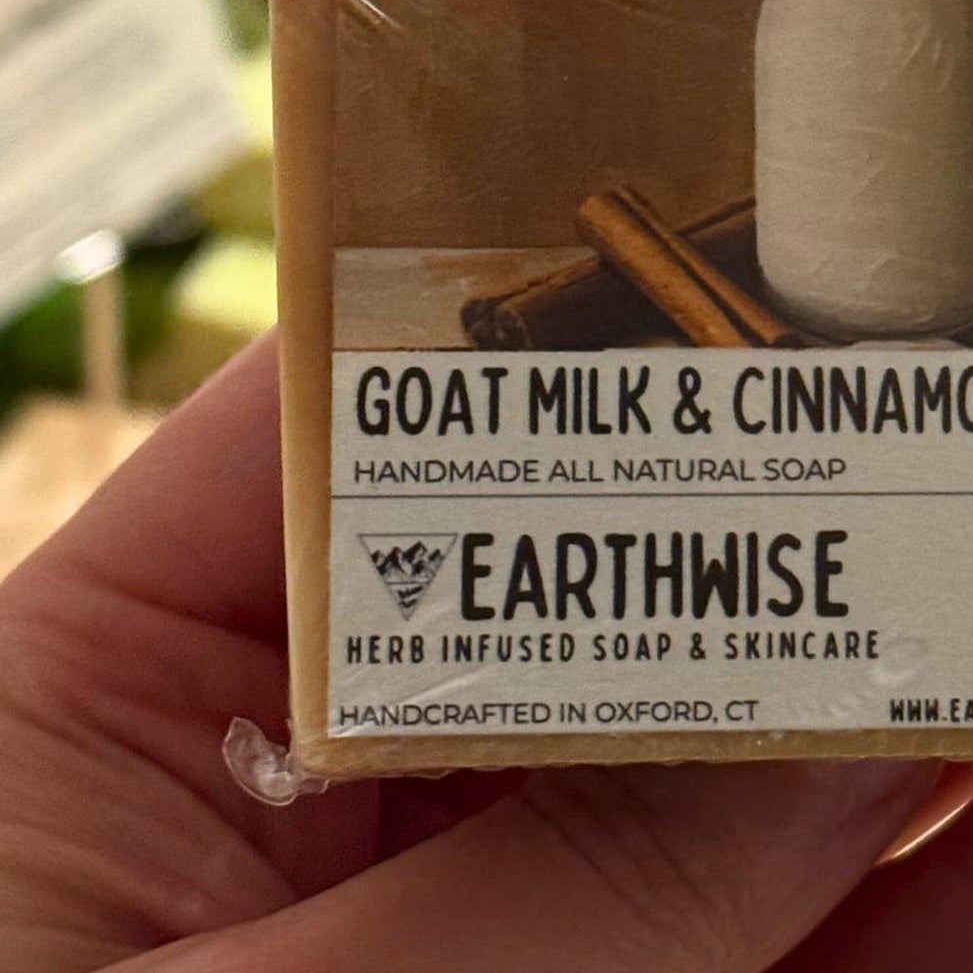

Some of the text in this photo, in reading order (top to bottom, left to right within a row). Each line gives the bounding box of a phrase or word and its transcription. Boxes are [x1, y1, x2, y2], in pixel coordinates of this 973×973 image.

[357, 366, 508, 436] GOAT
[529, 365, 651, 435] MILK
[673, 366, 711, 435] &
[354, 458, 846, 483] HANDMADE ALL NATURAL SOAP
[461, 531, 848, 621] EARTHWISE
[347, 631, 879, 664] HERB INFUSED SOAP & SKINCARE
[340, 700, 759, 726] HANDCRAFTED IN OXFORD, CT
